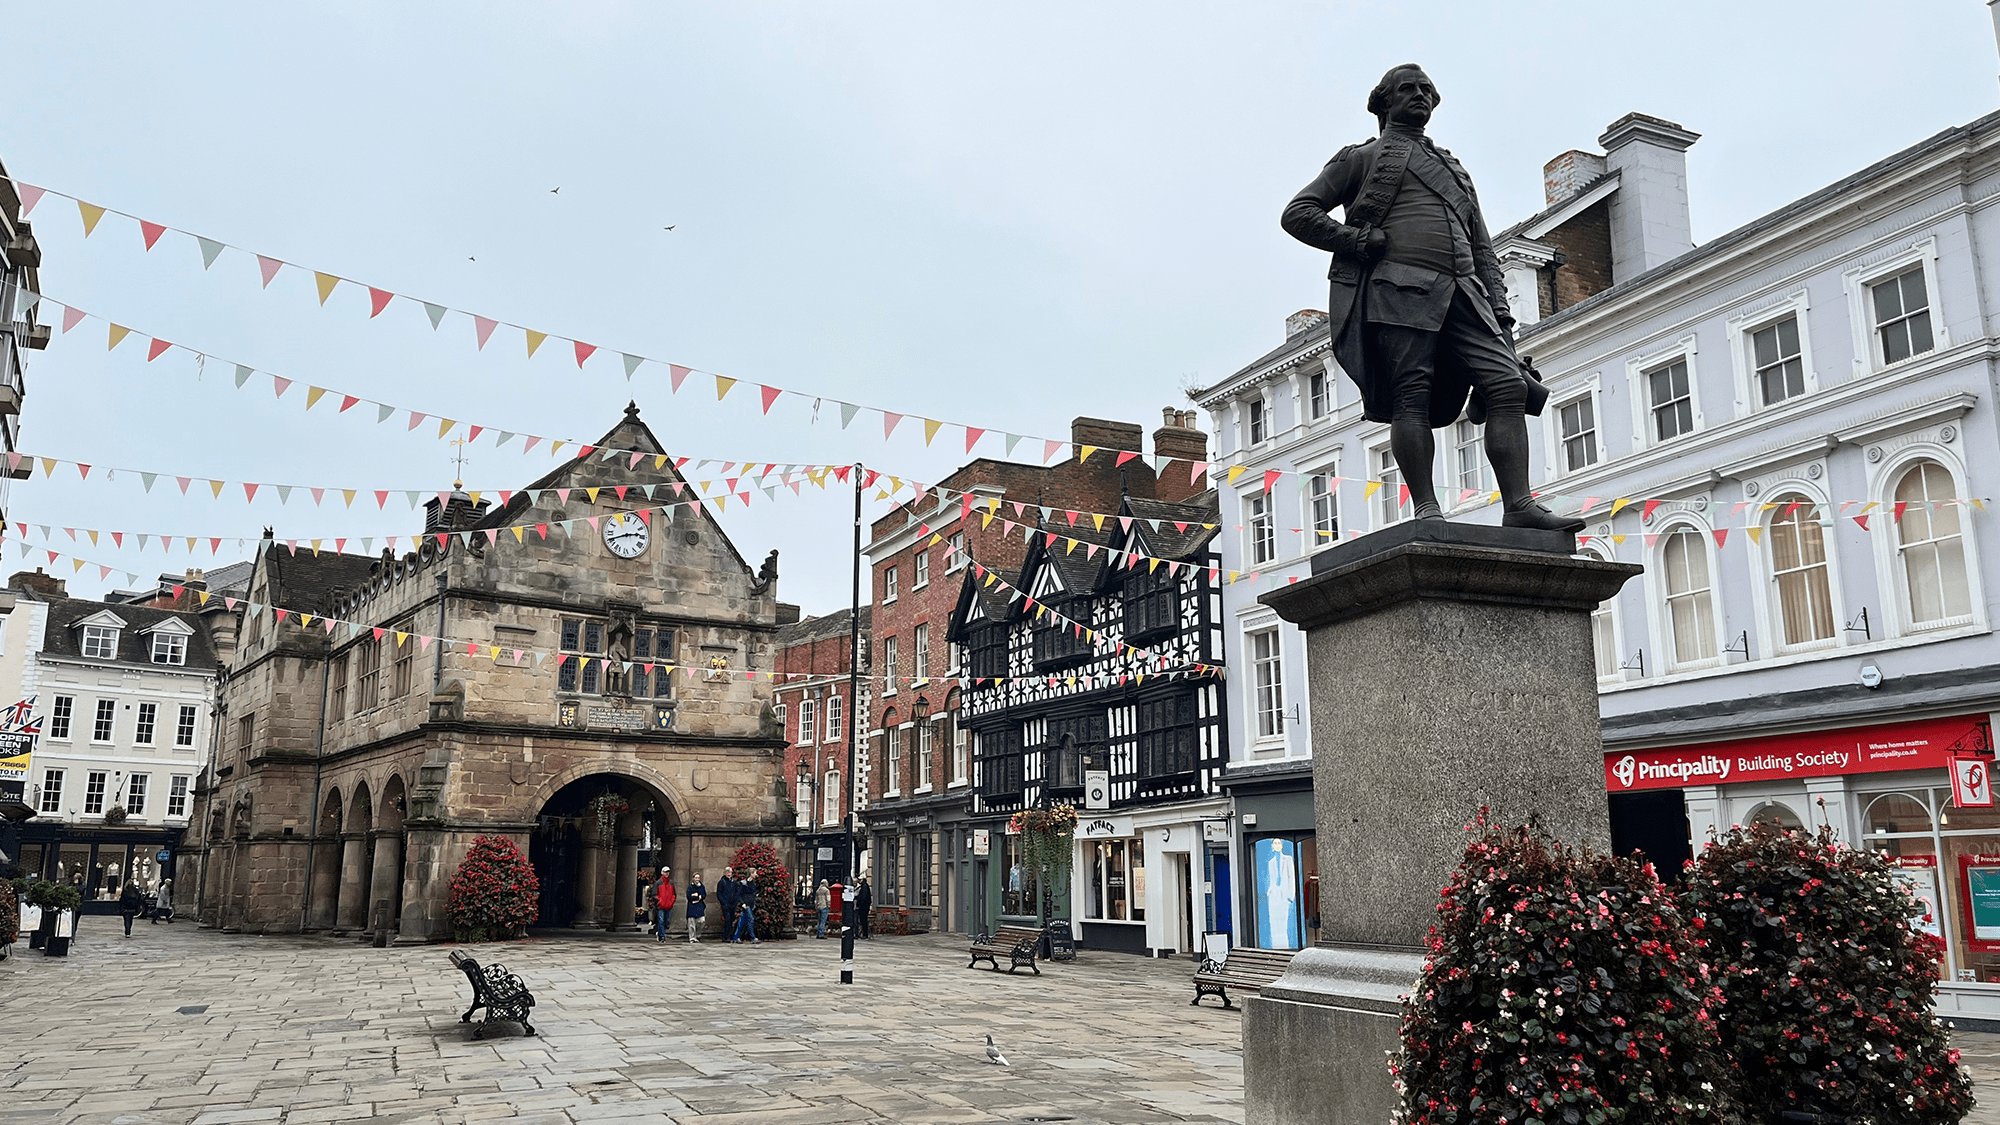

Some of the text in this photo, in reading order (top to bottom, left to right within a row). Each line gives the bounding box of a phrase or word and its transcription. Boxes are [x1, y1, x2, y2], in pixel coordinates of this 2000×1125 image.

[1870, 748, 1918, 760] principality.co.uk
[1638, 750, 1849, 782] Principality Building Society
[1086, 820, 1115, 835] FATFACE
